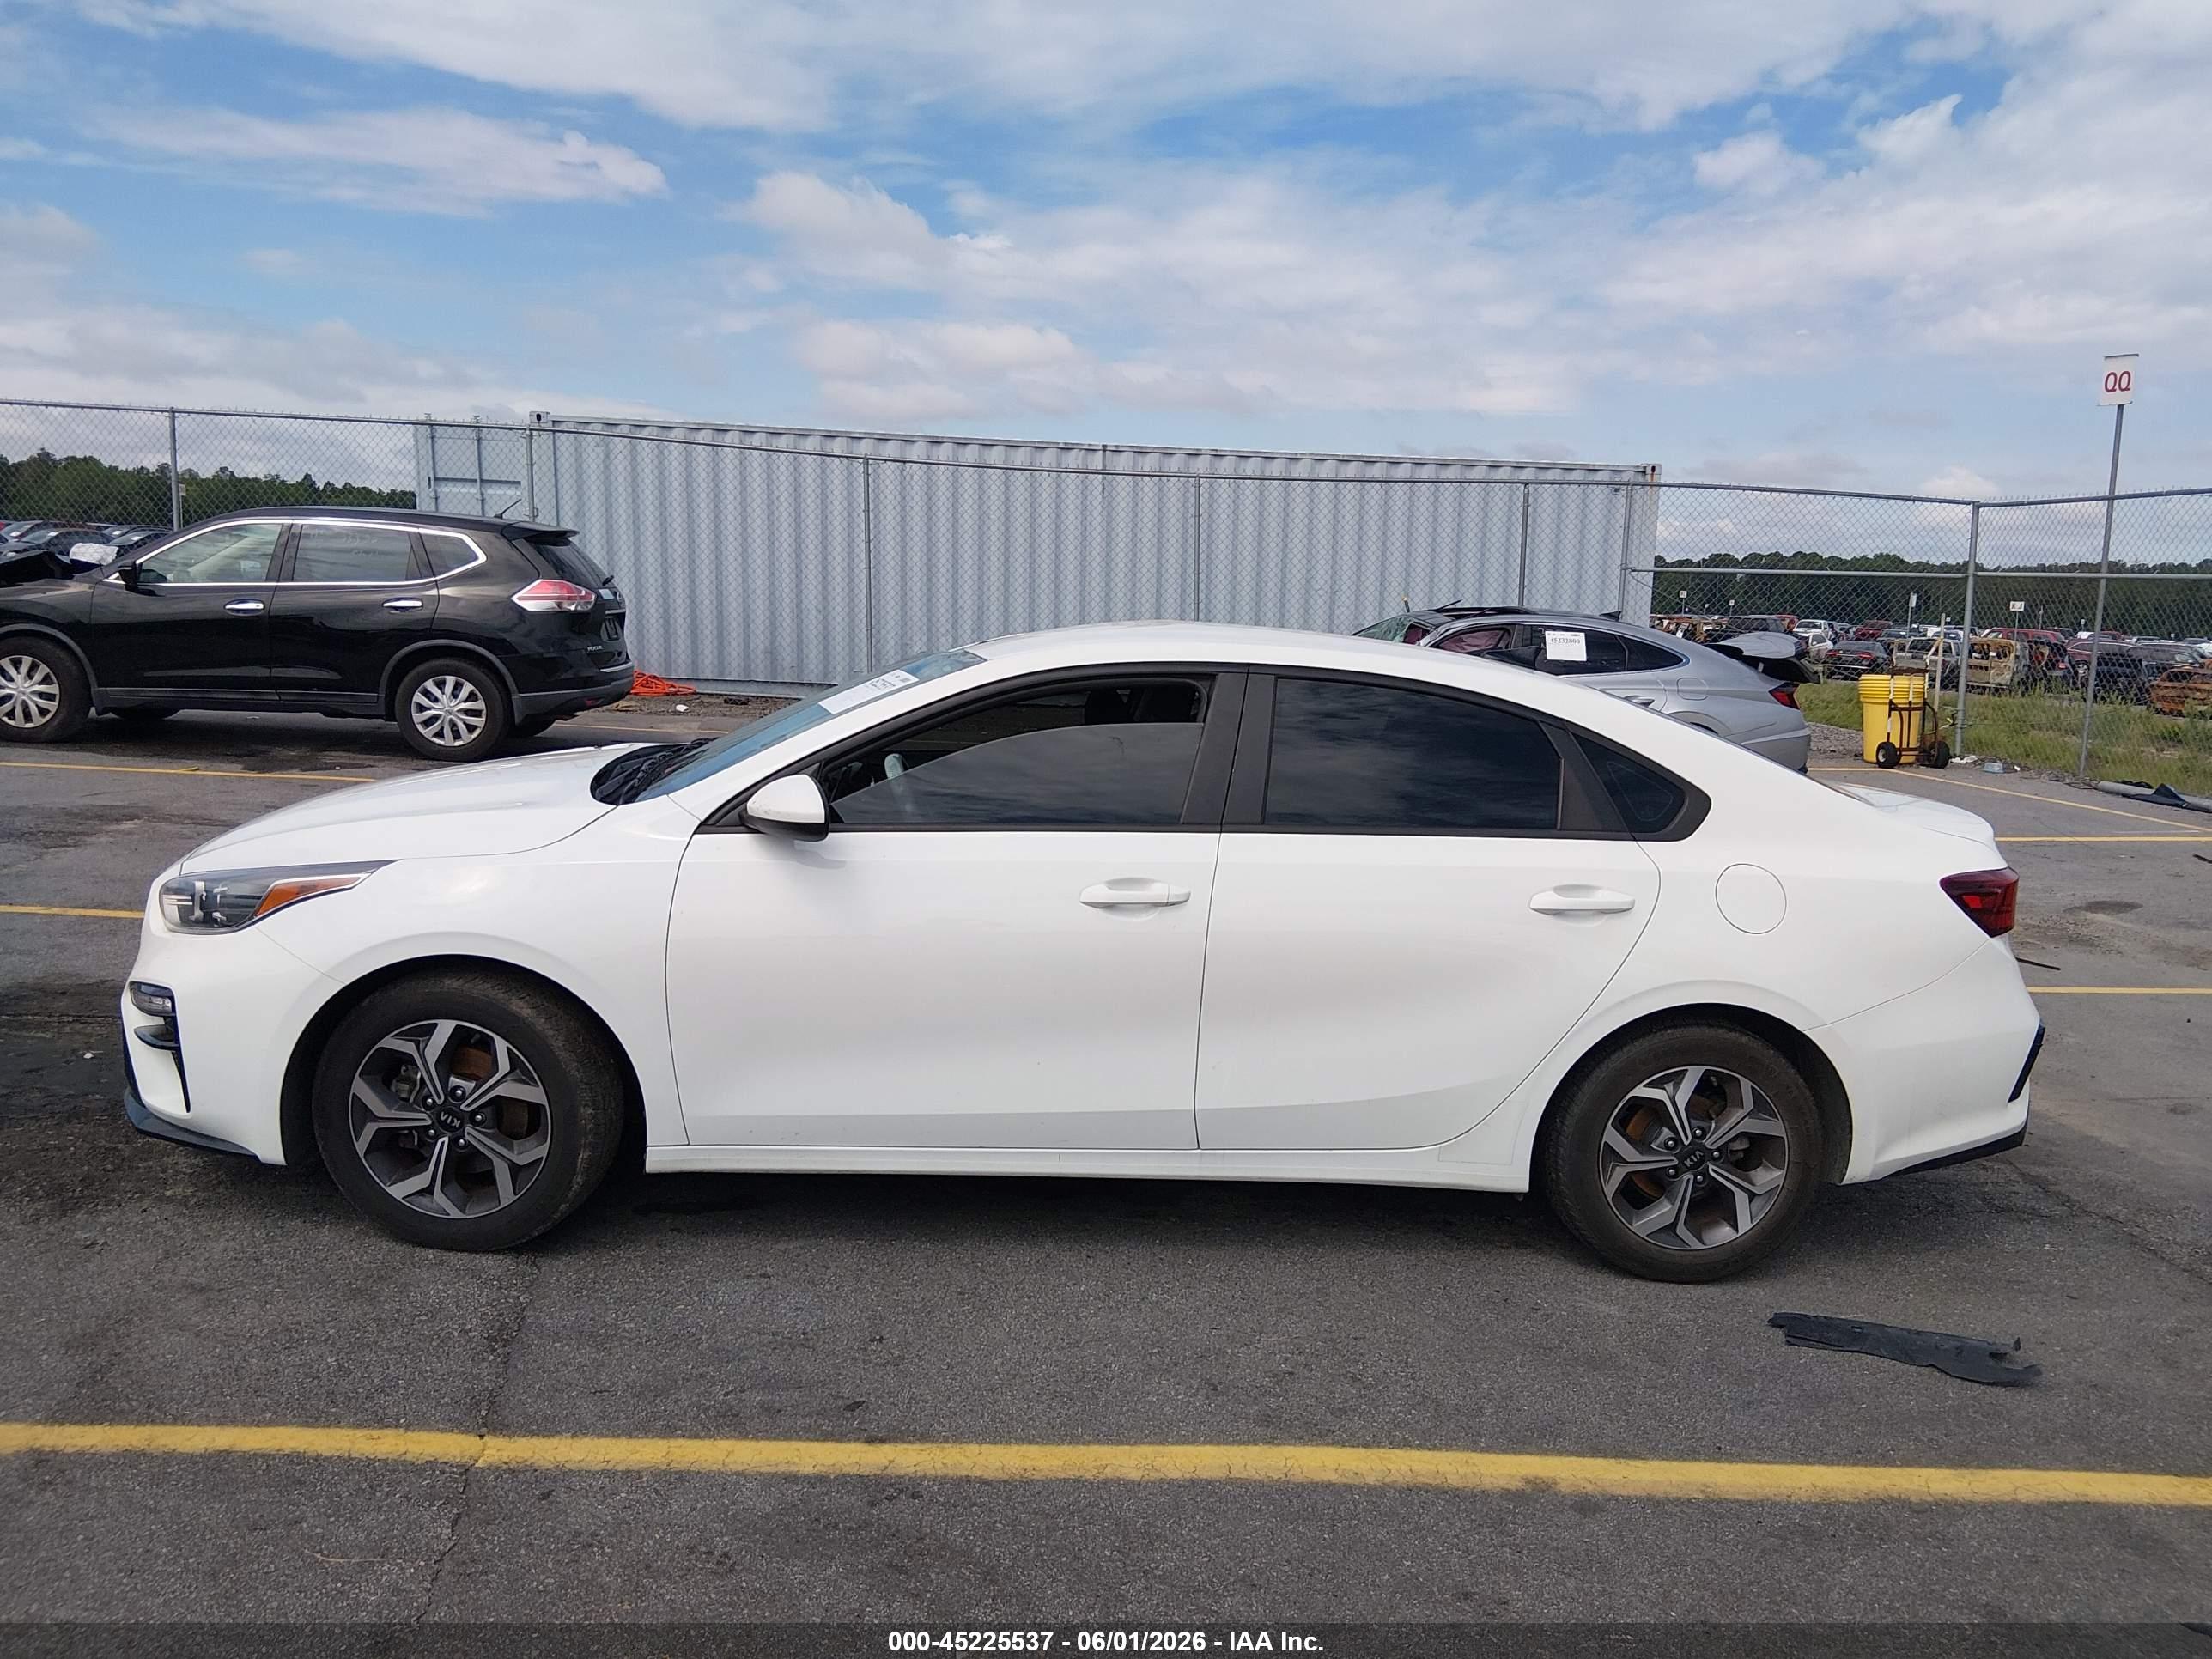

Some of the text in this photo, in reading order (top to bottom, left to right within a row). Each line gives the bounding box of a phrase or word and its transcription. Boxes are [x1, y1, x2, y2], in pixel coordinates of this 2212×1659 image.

[2104, 370, 2132, 393] QQ
[440, 1111, 461, 1128] KIA
[1683, 1150, 1705, 1168] KIA
